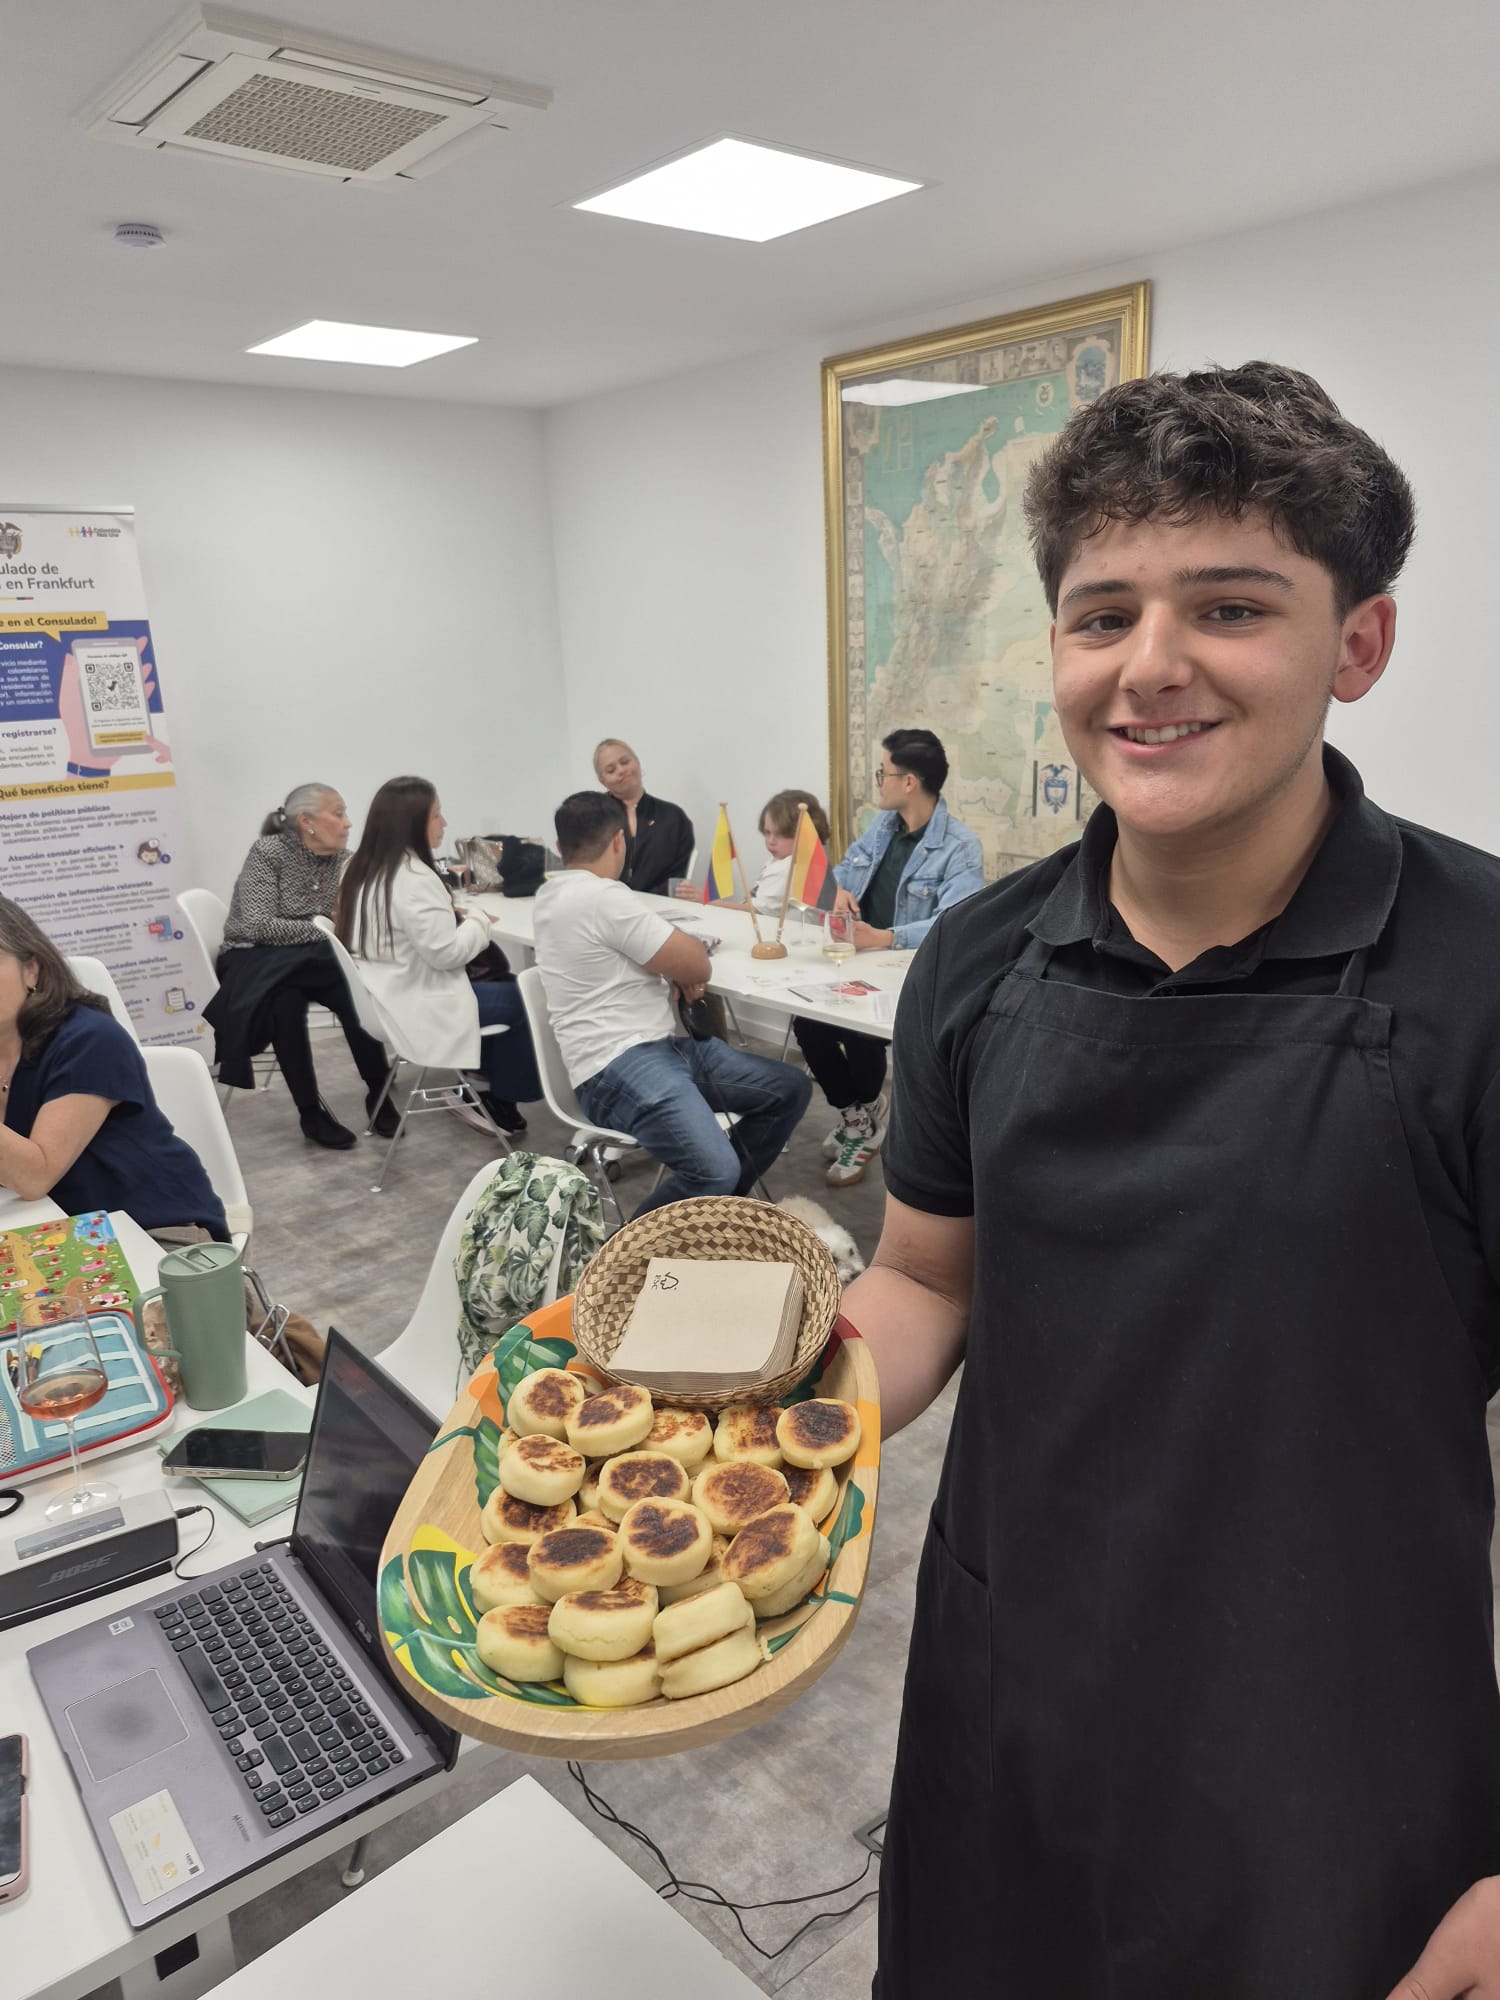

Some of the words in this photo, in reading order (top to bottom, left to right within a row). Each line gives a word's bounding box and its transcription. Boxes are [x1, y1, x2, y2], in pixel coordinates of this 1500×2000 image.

[41, 562, 59, 575] de
[6, 580, 23, 590] en
[28, 578, 95, 590] Frankfurt
[24, 618, 34, 626] el
[37, 616, 97, 626] Consulado!
[2, 728, 56, 739] registrarse?
[21, 782, 75, 796] beneficios
[78, 780, 110, 790] tiene?
[42, 808, 76, 818] políticas
[78, 804, 110, 814] públicas
[8, 852, 45, 862] Atención
[68, 884, 114, 896] información
[44, 1554, 114, 1585] BOSE
